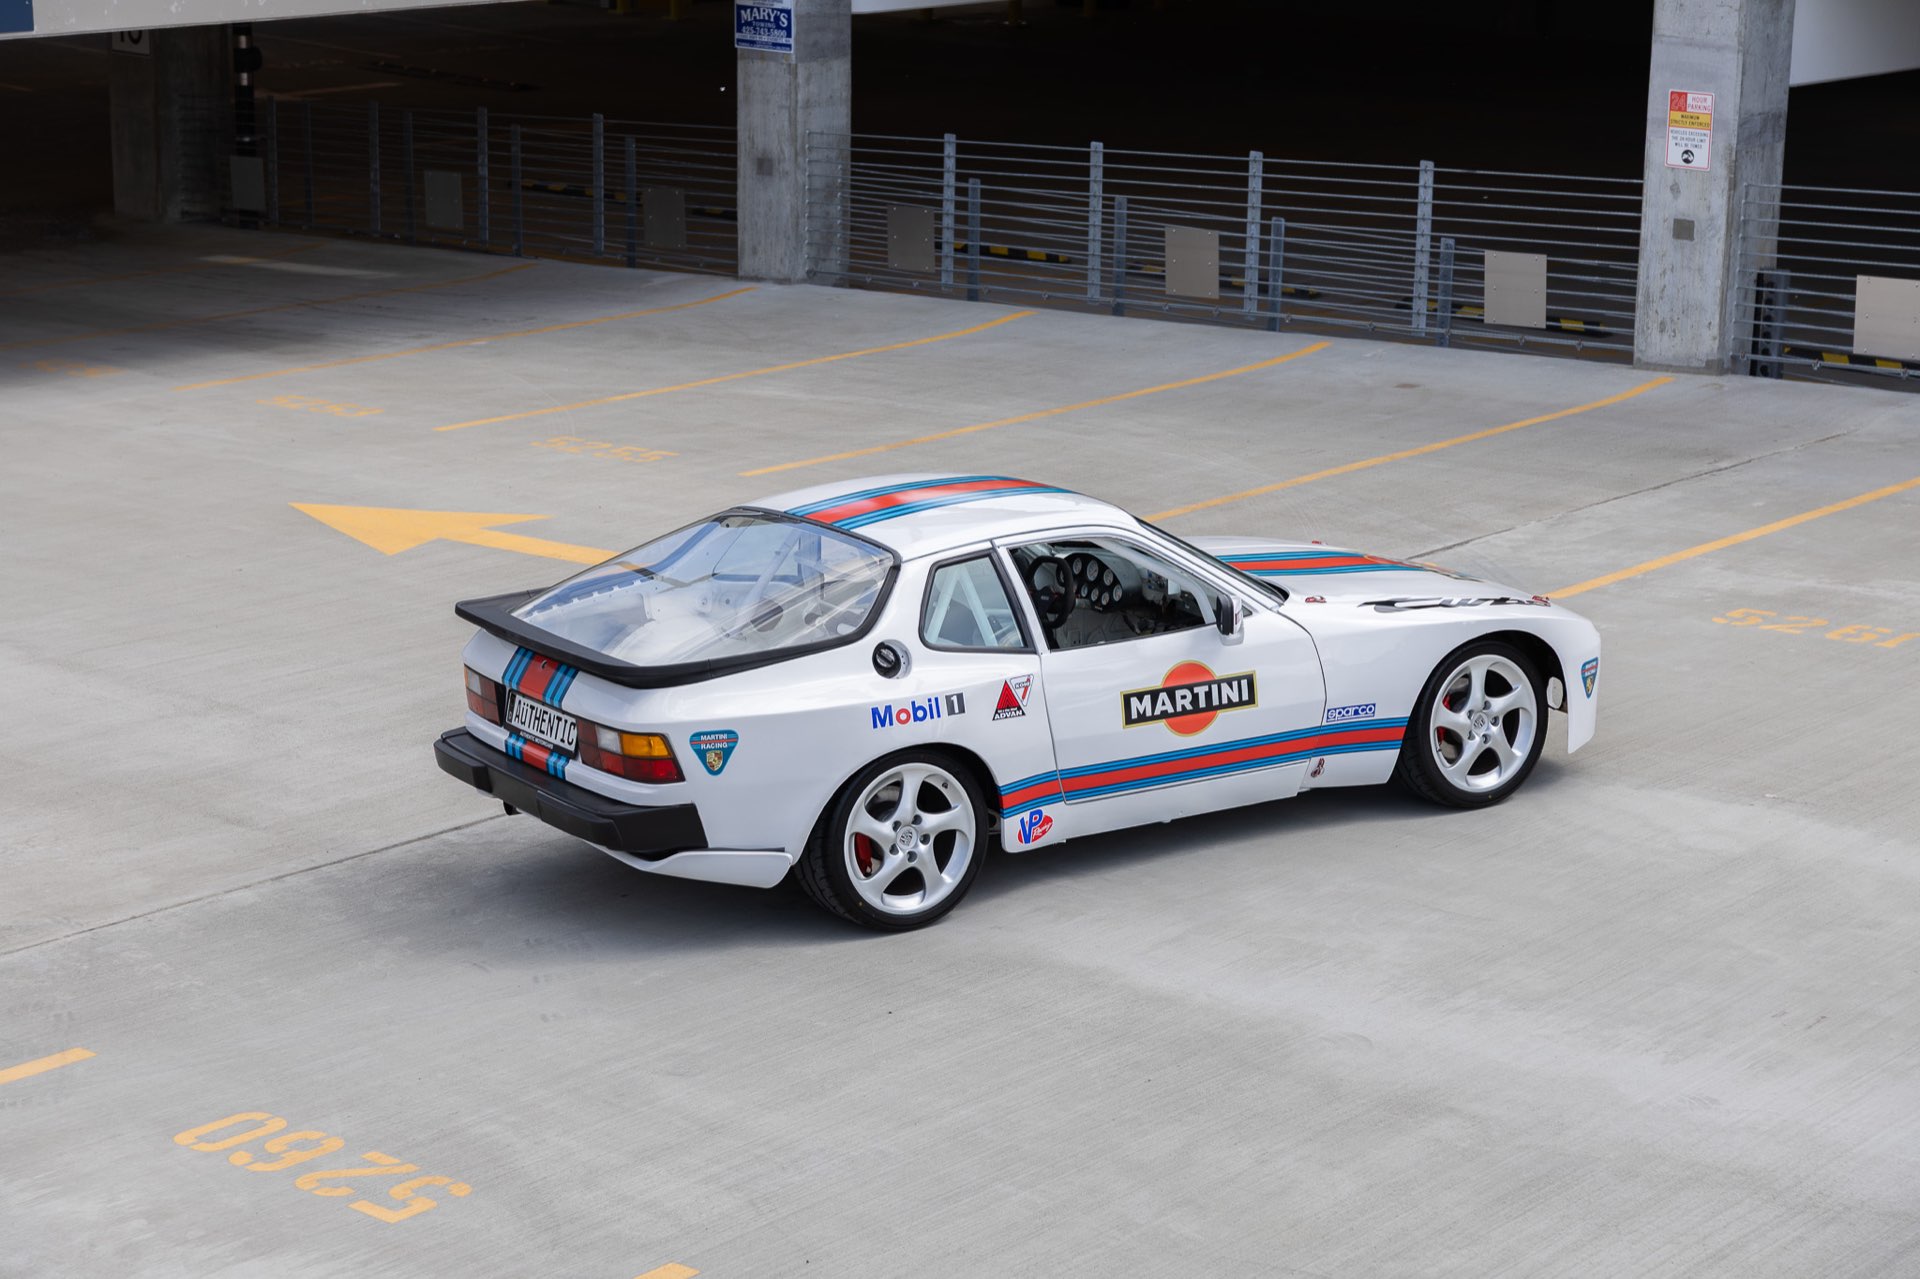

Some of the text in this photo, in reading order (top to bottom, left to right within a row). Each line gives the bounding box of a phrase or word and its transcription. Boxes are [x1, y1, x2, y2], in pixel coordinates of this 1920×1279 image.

[740, 7, 788, 27] MARY'S
[1671, 93, 1686, 111] 24
[1687, 103, 1711, 112] PARKING
[1129, 678, 1250, 720] MARTINI
[870, 696, 942, 729] Mobil
[994, 710, 1023, 720] ADVAN
[1327, 704, 1375, 720] sparco
[700, 733, 728, 741] MARTINI
[700, 742, 728, 750] RACING
[1019, 809, 1044, 844] VP
[172, 1112, 473, 1224] 5260
